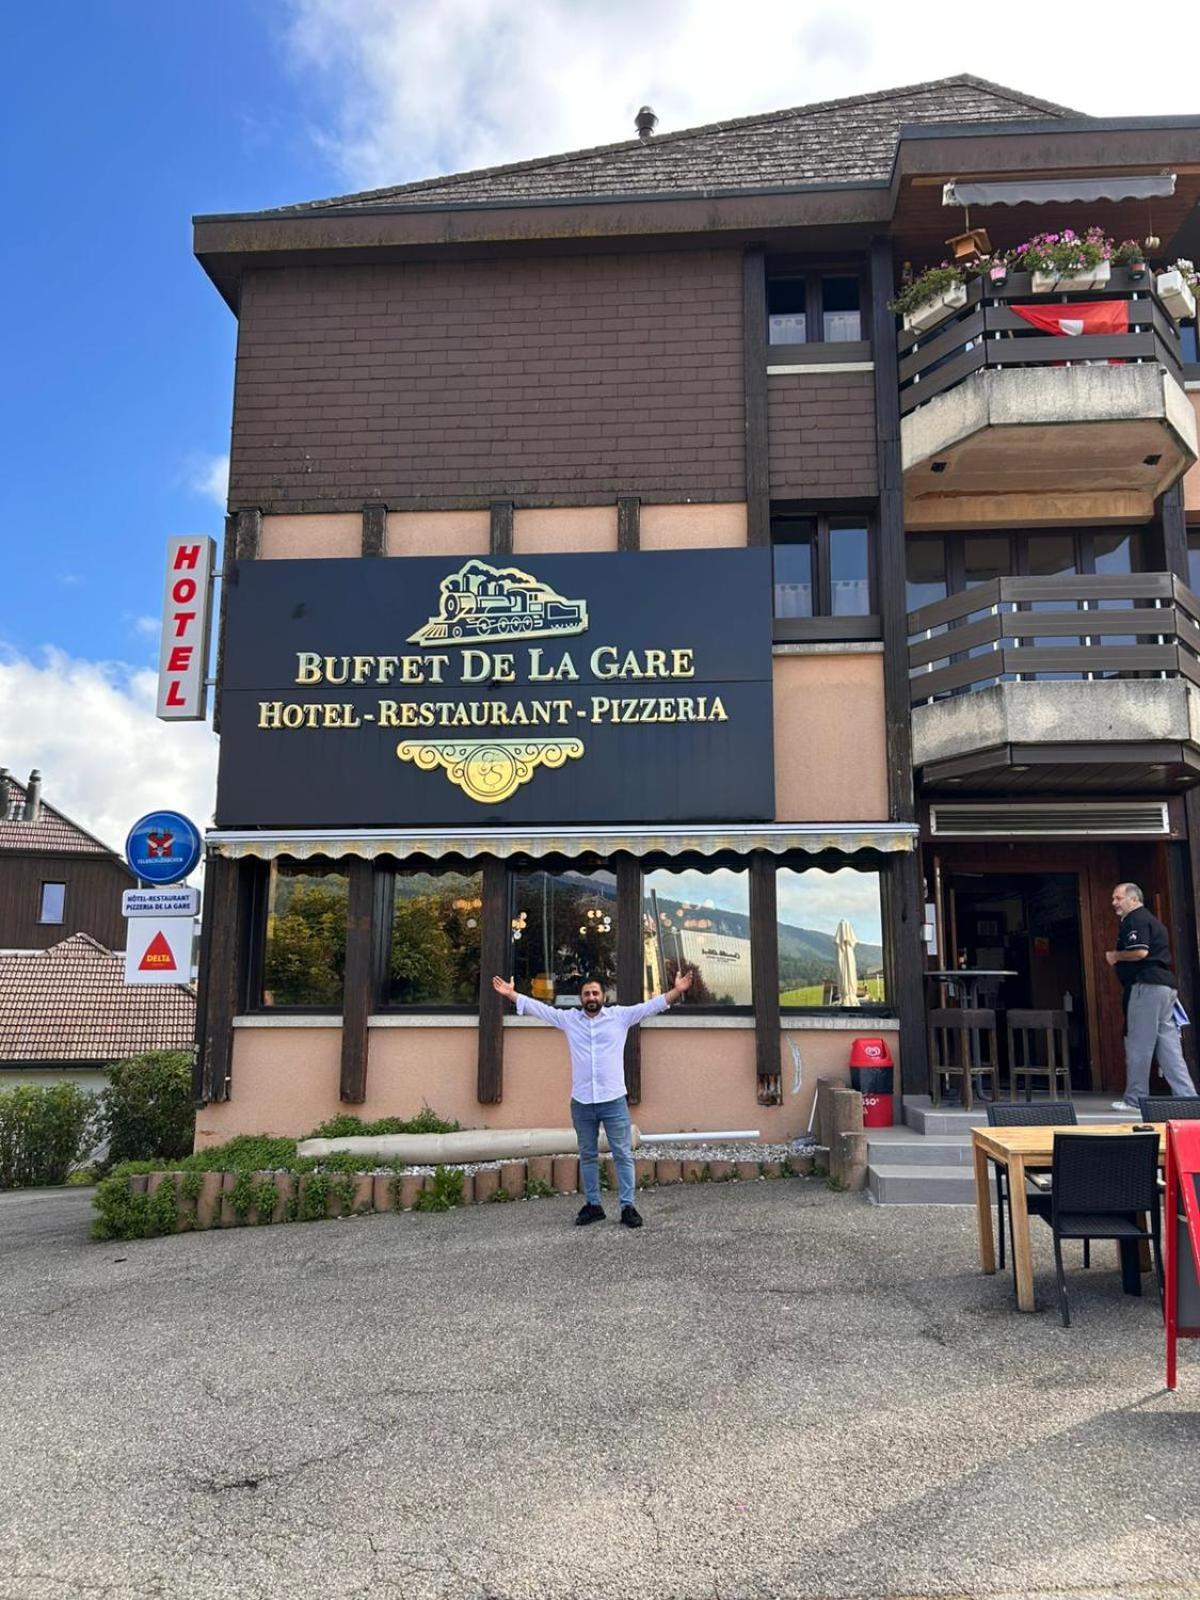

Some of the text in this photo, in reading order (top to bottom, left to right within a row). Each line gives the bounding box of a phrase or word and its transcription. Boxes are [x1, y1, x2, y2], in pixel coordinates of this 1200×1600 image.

[165, 545, 201, 706] HOTEL
[295, 646, 696, 685] BUFFET DE LA GARE
[126, 903, 154, 911] PIZZERIA
[146, 954, 171, 962] DELTA
